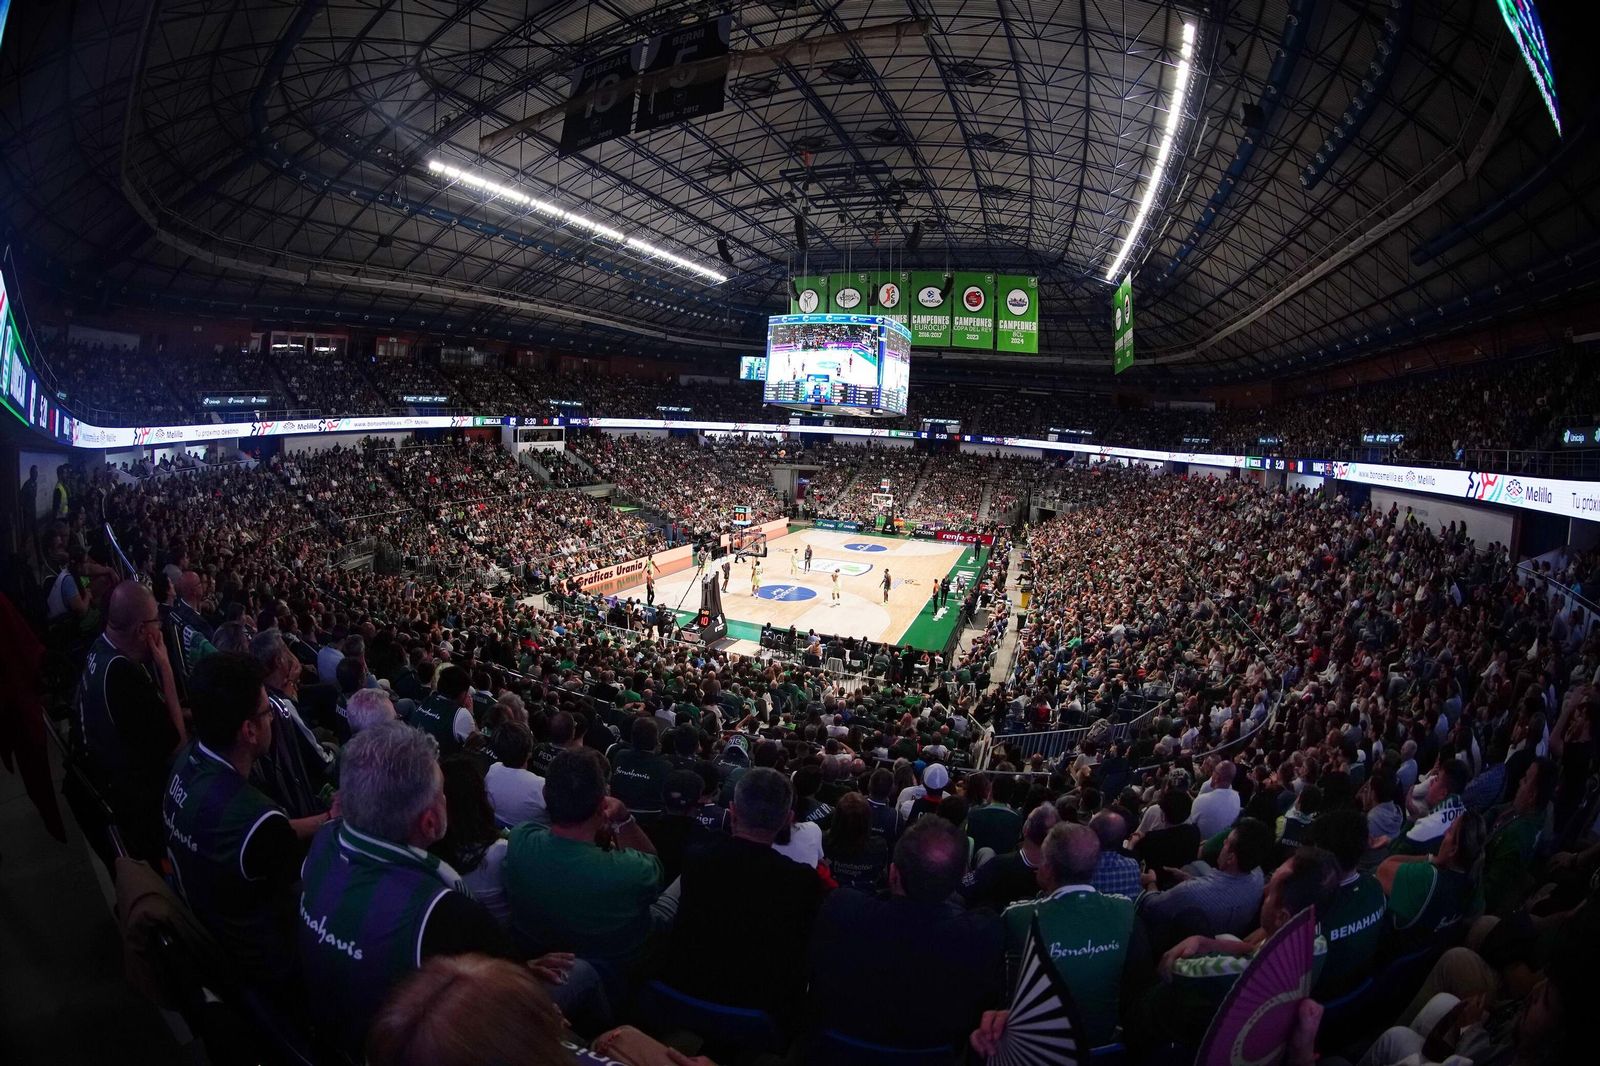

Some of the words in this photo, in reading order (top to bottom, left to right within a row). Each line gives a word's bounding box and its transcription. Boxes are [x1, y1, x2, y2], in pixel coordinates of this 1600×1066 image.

[584, 53, 630, 80] CABEZAS
[912, 315, 950, 325] CAMPEONES
[954, 316, 992, 328] CAMPEONES
[999, 320, 1037, 331] CAMPEONES
[1010, 337, 1024, 345] 2024
[524, 417, 537, 425] 5:20
[297, 423, 318, 431] Melilla
[935, 432, 948, 440] 5:20
[1570, 433, 1585, 444] Unicaja
[1275, 459, 1285, 470] 5:20
[1417, 474, 1436, 486] Melilla
[1525, 485, 1553, 504] Melilla
[1571, 491, 1581, 509] Tu
[1582, 493, 1600, 514] próxi
[735, 513, 745, 521] 10
[942, 532, 965, 543] renfe
[576, 569, 614, 587] Gráficas
[616, 560, 643, 577] Urania
[169, 773, 188, 809] Díaz
[1050, 939, 1120, 960] Benahavis
